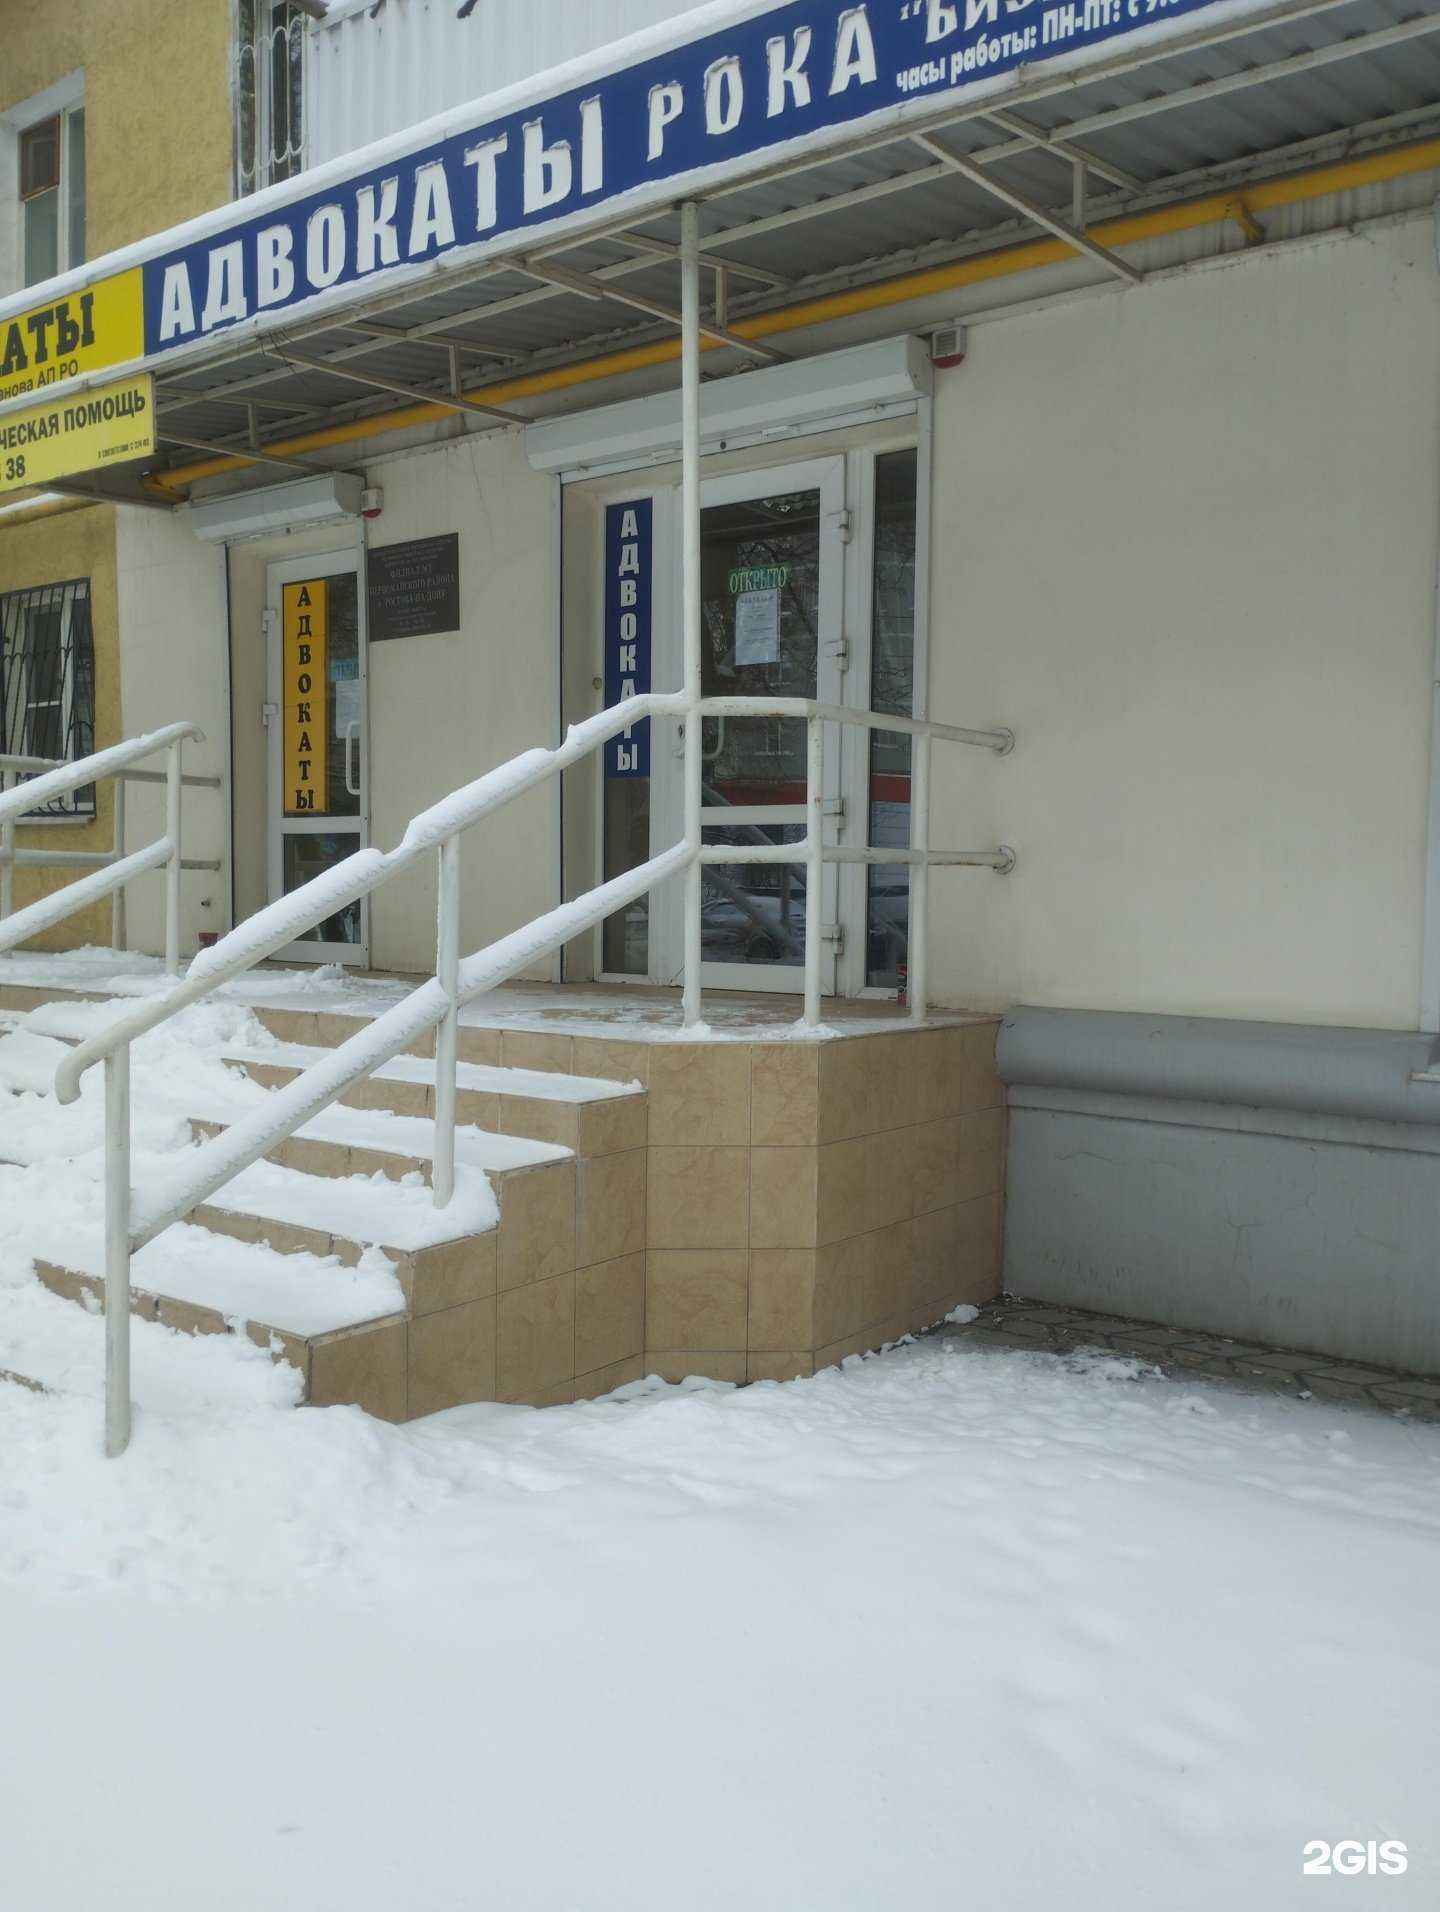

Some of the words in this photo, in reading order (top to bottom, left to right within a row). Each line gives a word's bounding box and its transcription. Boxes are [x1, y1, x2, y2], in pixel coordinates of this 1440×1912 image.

[896, 57, 946, 93] часы
[951, 26, 1037, 84] работы:
[159, 95, 603, 342] АДВОКАТЫ
[646, 3, 878, 163] РОКА
[37, 366, 56, 389] АП
[60, 359, 79, 381] РО
[64, 389, 146, 433] ПОМОЩЬ
[5, 454, 26, 481] 38
[729, 566, 787, 593] ОТКРЫТО
[296, 586, 314, 810] АДВОКАТЫ
